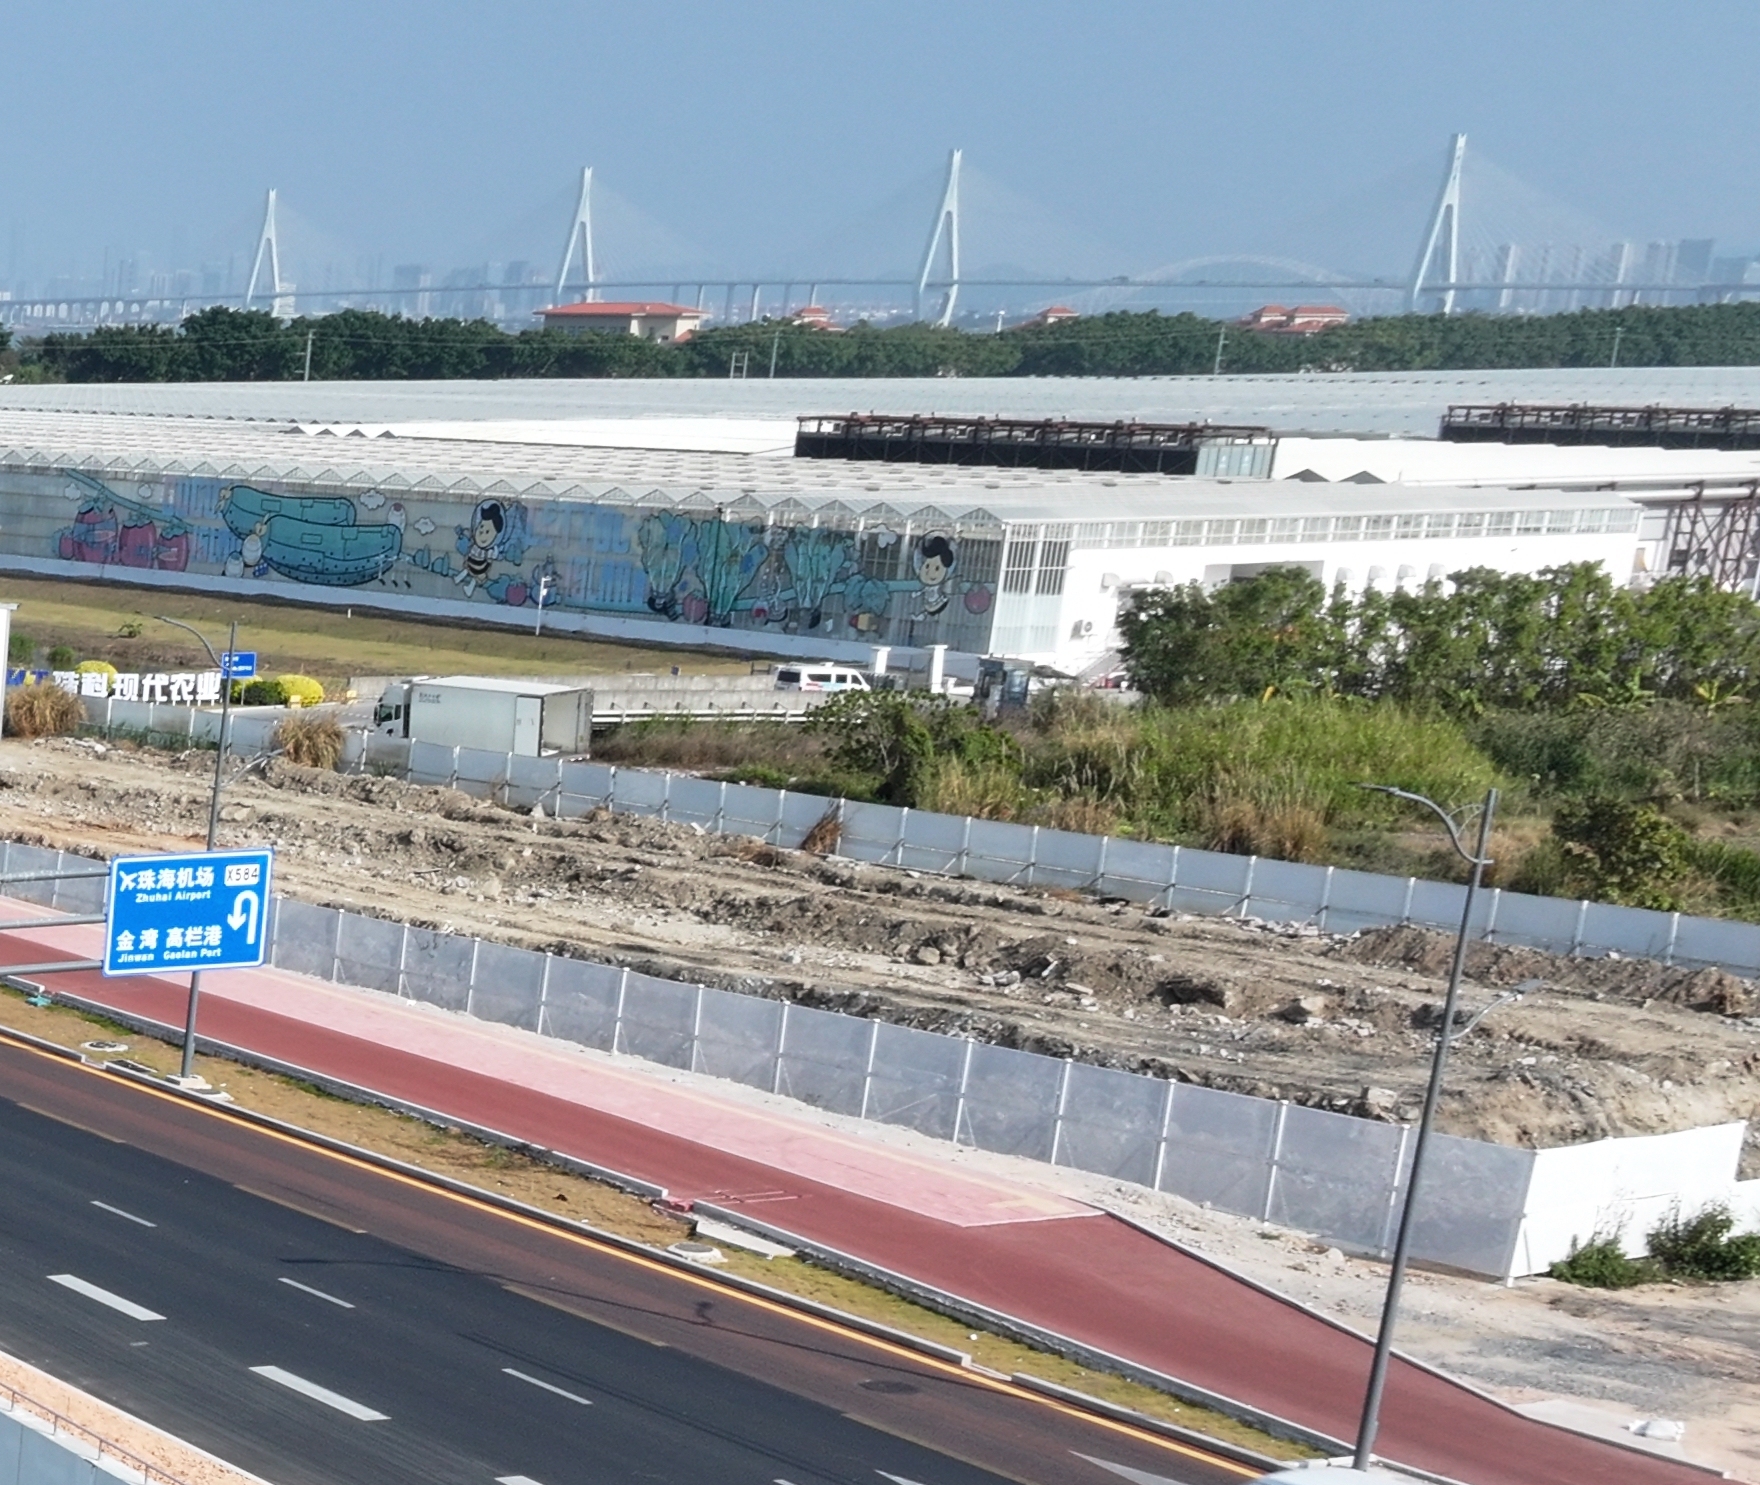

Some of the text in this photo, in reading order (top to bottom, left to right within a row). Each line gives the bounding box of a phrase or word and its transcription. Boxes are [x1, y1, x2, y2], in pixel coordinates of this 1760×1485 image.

[137, 866, 215, 890] 珠海机场
[227, 868, 259, 881] X584
[136, 890, 211, 903] Zhuhai Airport
[116, 925, 222, 951] 金湾 高栏港
[117, 948, 222, 963] Jinwan Gaolan Port
